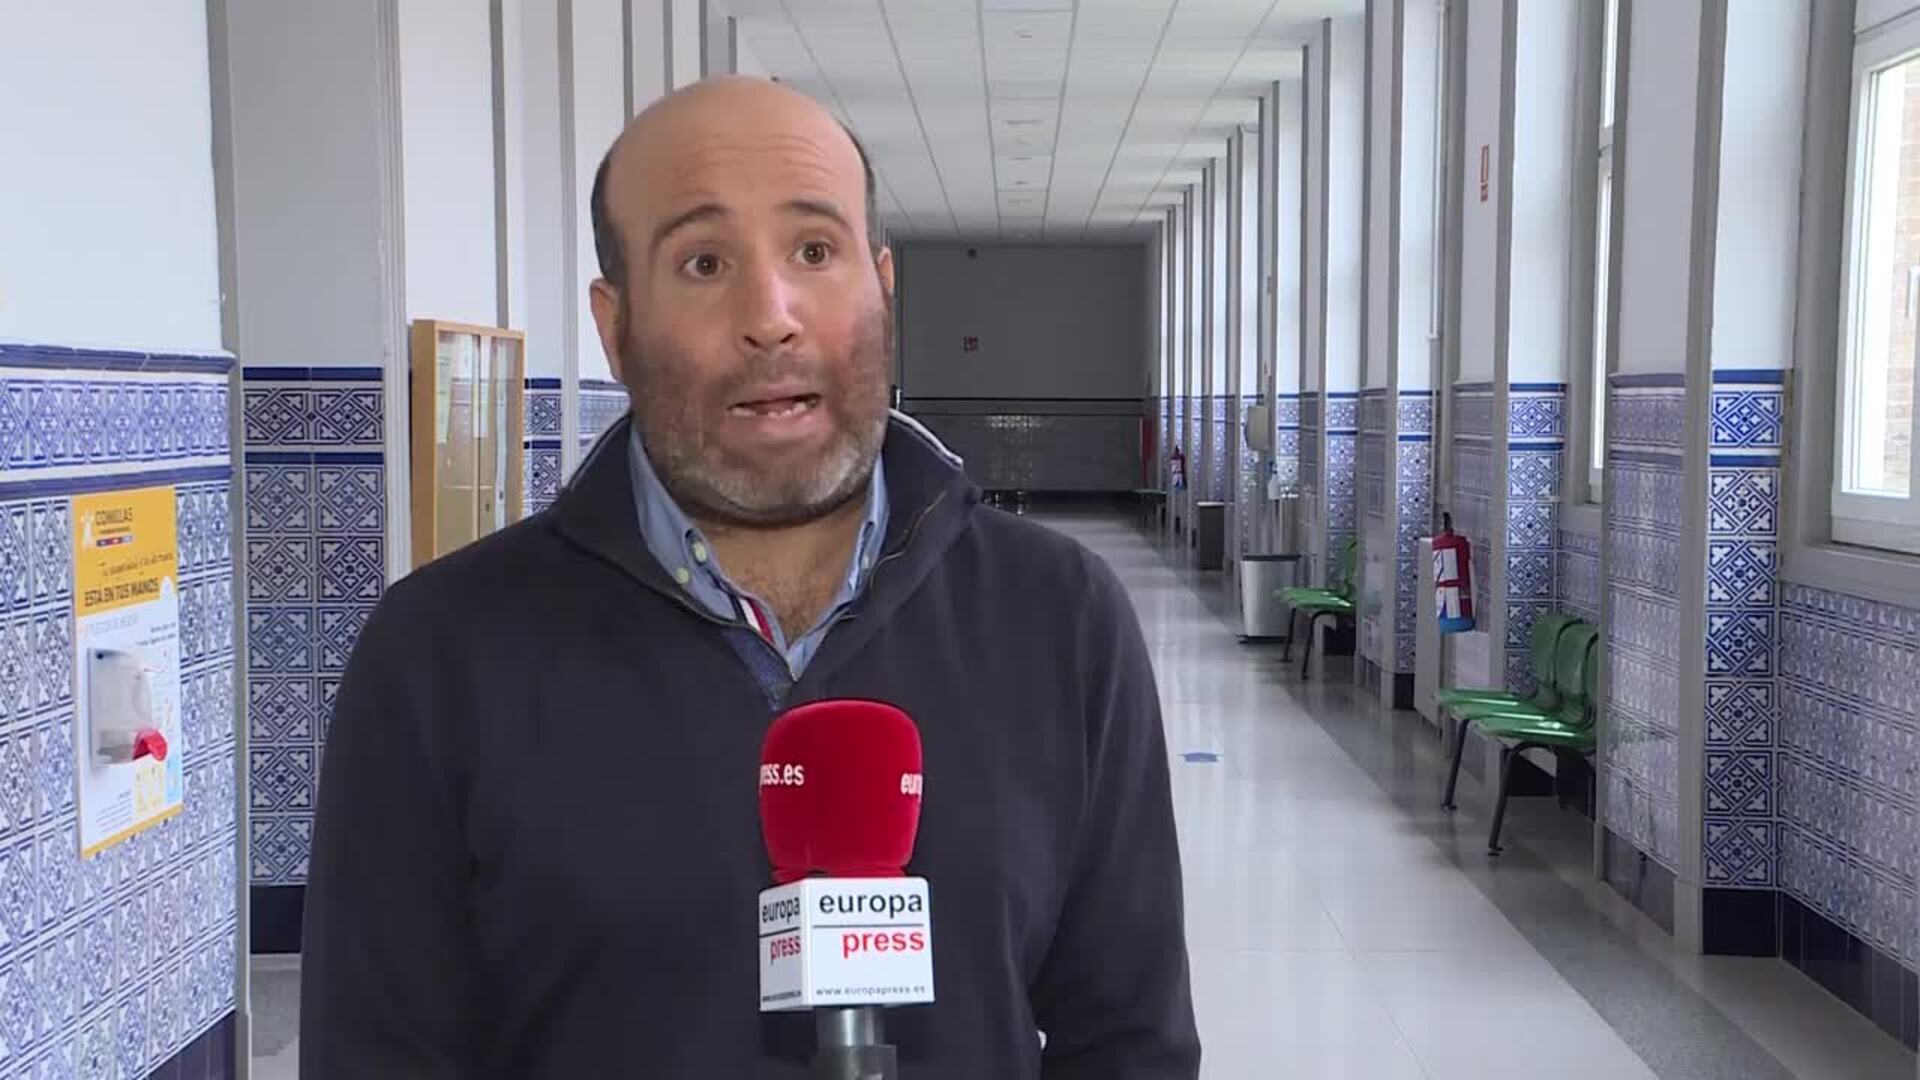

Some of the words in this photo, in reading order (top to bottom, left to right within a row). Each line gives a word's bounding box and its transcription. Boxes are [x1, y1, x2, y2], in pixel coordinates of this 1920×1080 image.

[761, 896, 800, 924] europa
[819, 894, 922, 920] europa
[771, 936, 802, 966] press
[842, 932, 925, 959] press
[815, 985, 926, 998] www.europapress.es
